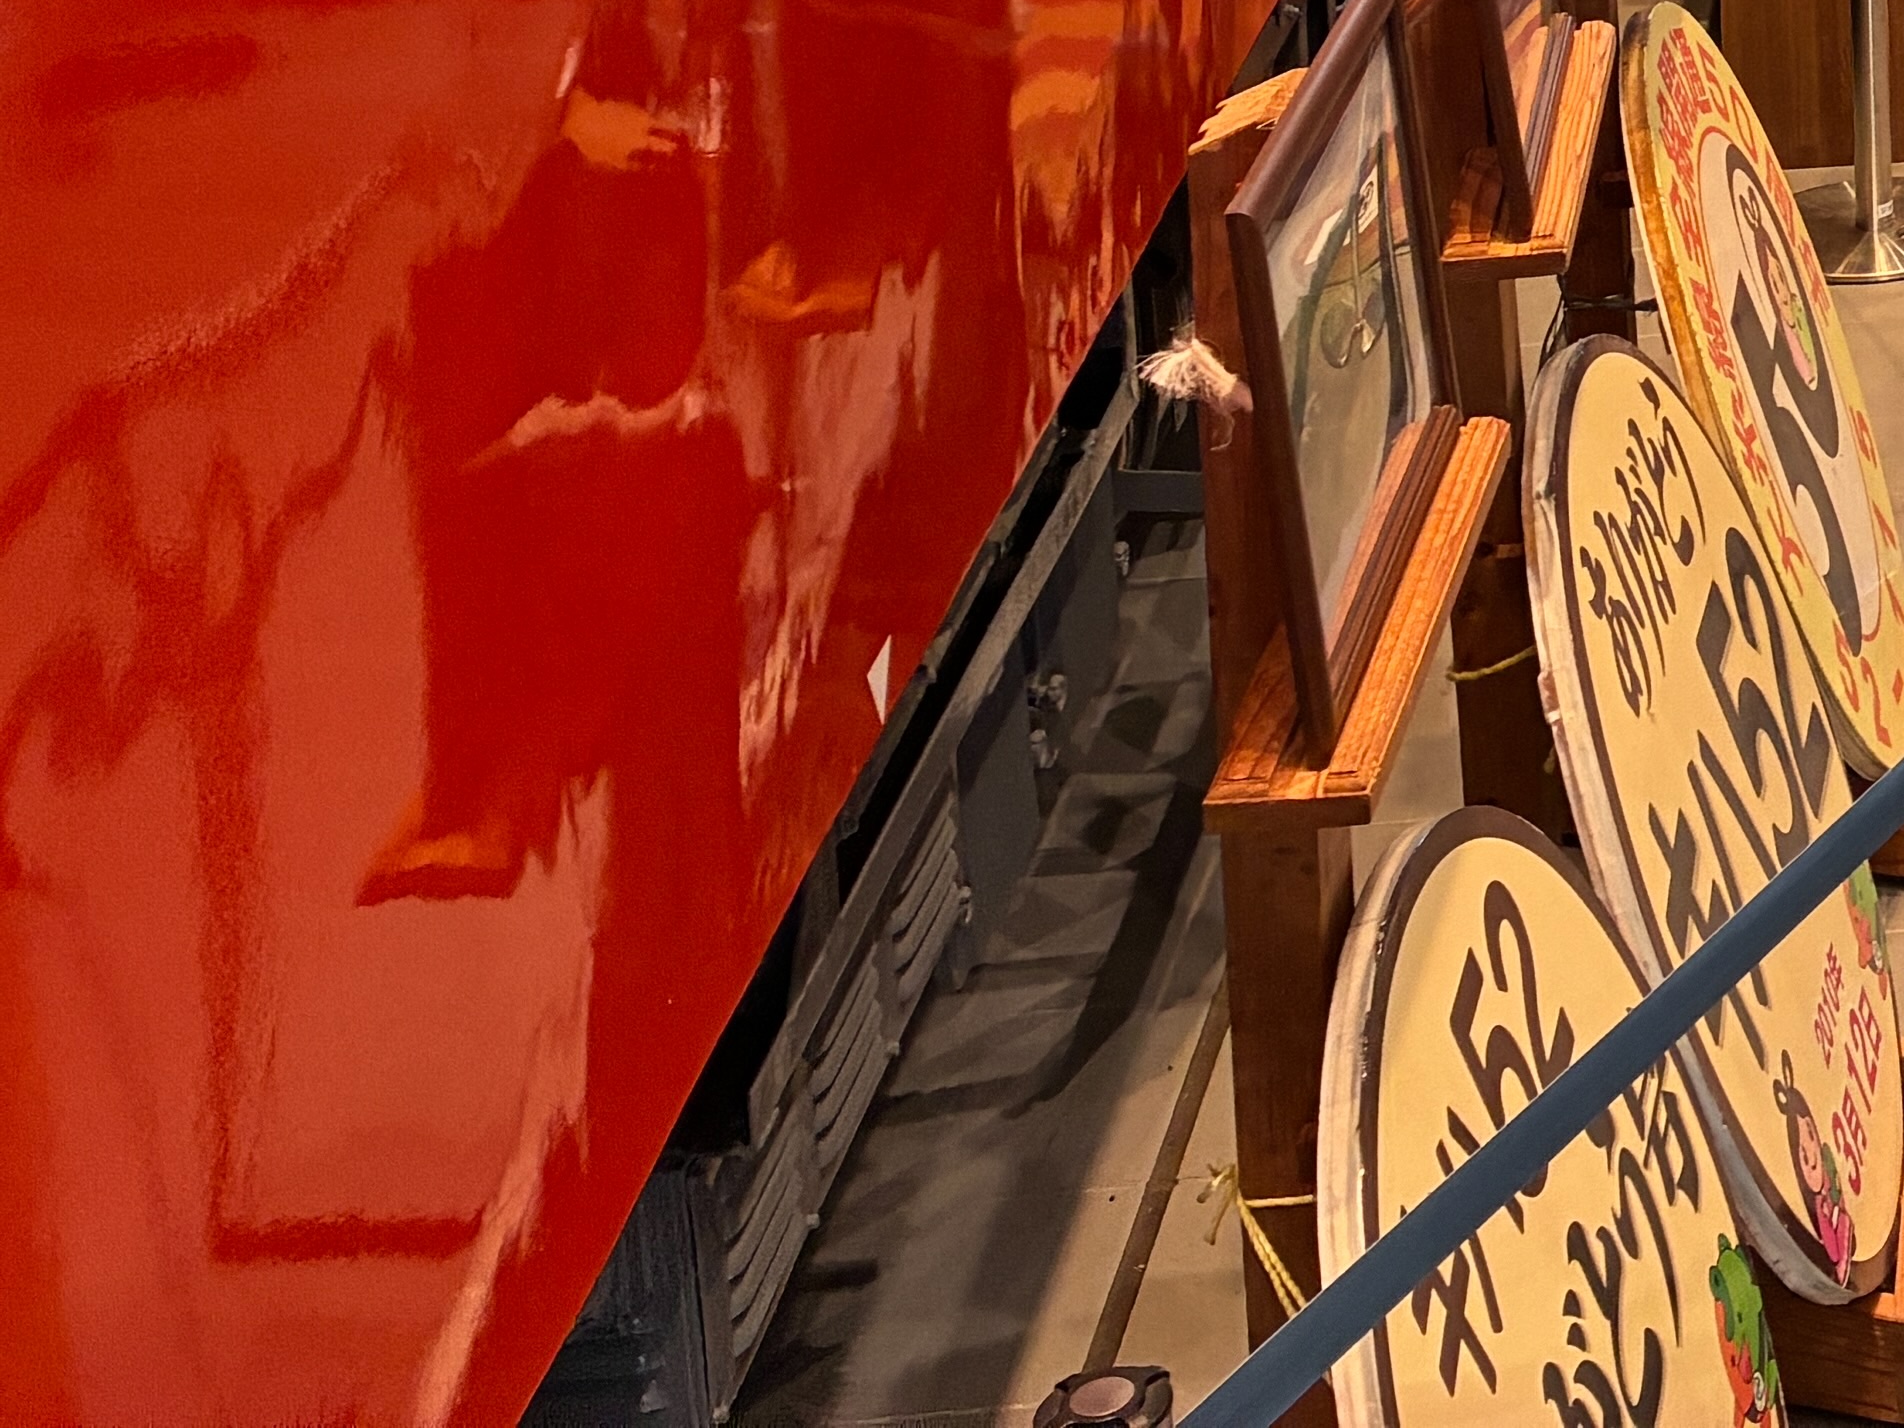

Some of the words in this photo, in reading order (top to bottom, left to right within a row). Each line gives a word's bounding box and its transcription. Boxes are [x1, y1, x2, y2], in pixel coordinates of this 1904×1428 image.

[1578, 375, 1706, 719] ありがとう
[1813, 941, 1845, 1070] 2010年
[1831, 984, 1884, 1197] 3月12日
